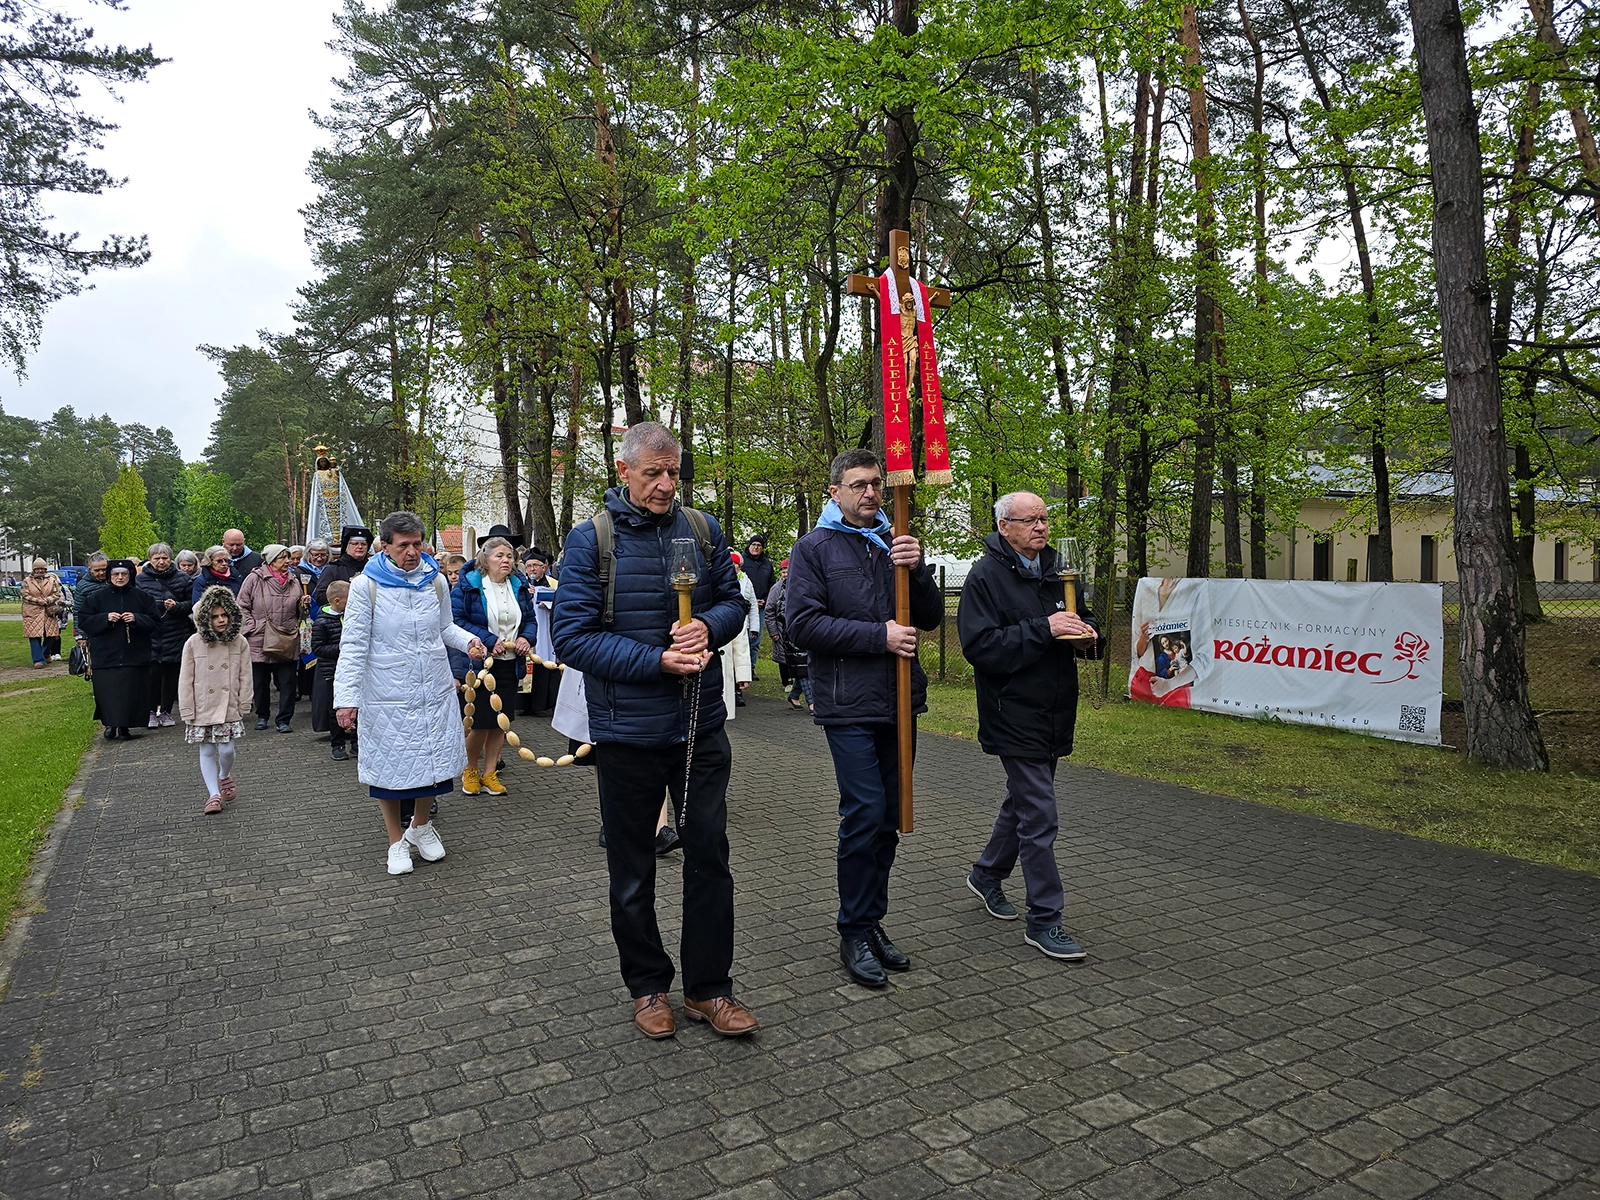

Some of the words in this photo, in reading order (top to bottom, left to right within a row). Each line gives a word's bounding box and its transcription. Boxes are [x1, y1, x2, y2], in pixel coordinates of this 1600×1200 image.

[887, 337, 903, 423] ALLELUJA
[922, 341, 940, 424] ALLELUJA
[1213, 618, 1291, 631] MIESIĘCZNIK
[1297, 623, 1387, 637] FORMACYJNY
